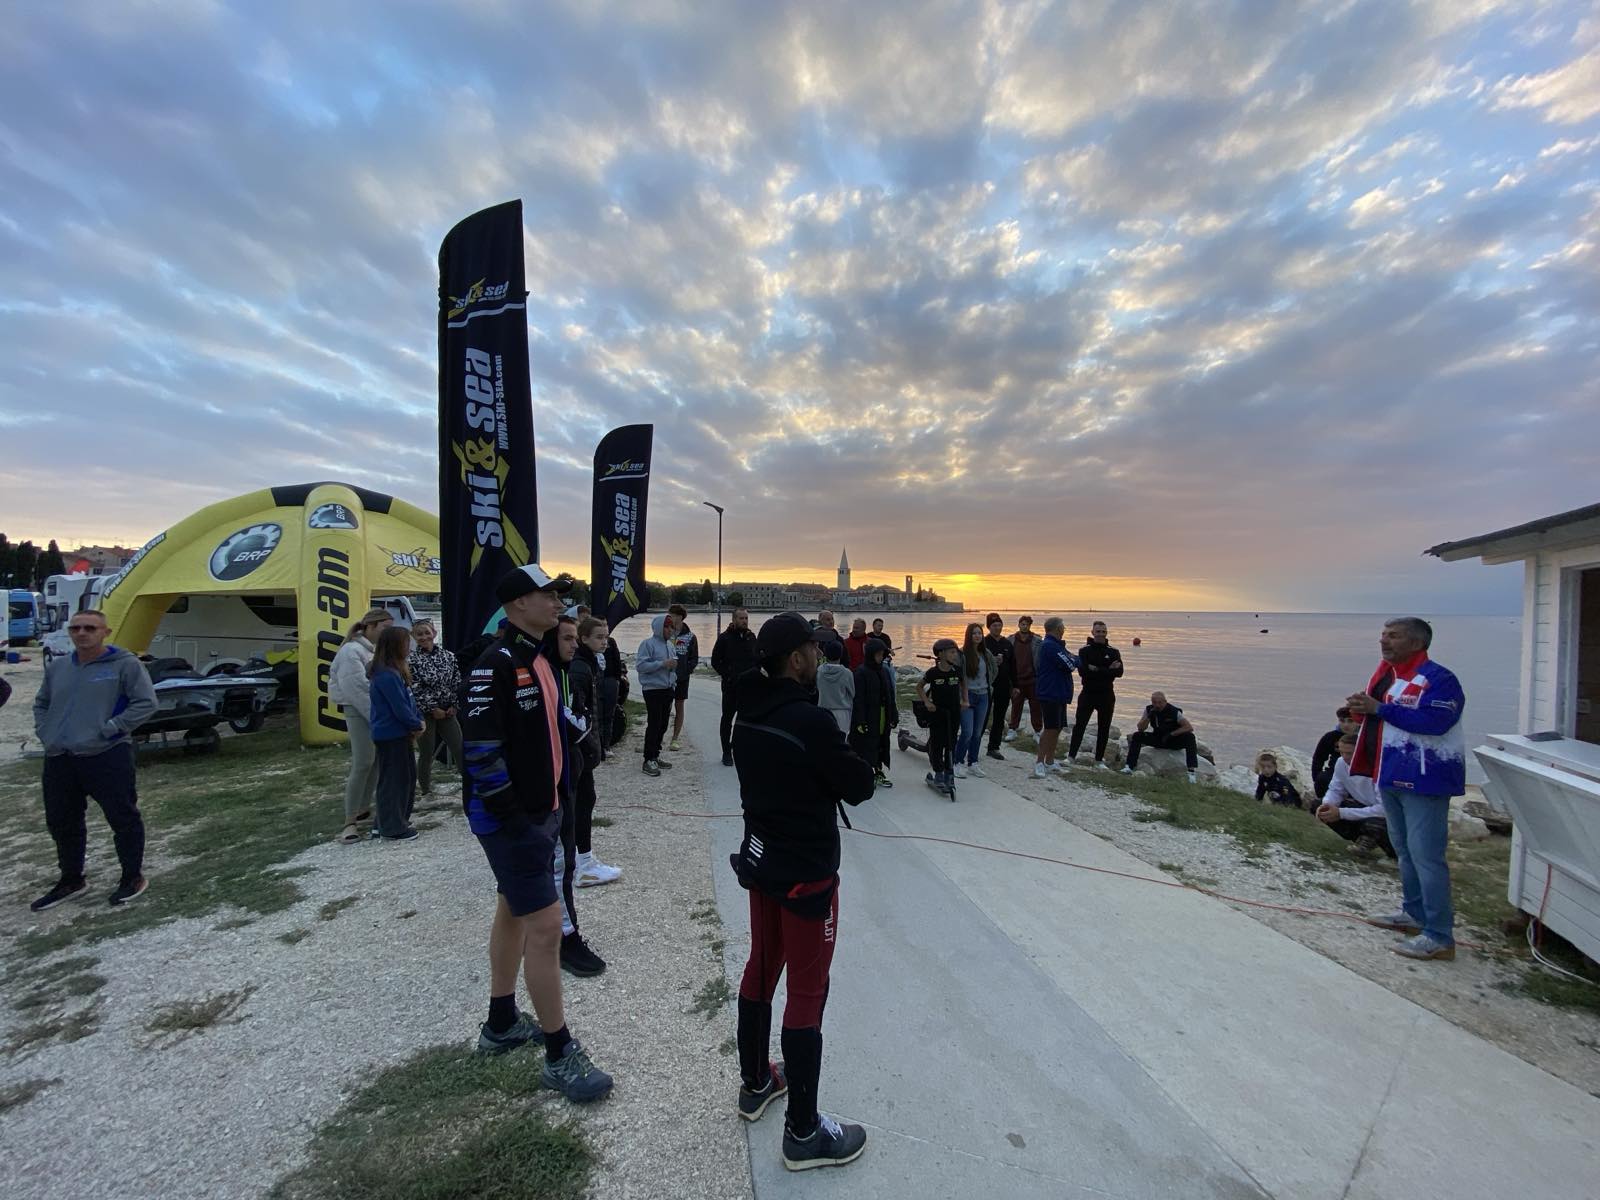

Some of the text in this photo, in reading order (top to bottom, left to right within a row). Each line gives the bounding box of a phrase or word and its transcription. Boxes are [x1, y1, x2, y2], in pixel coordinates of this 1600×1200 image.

[464, 347, 495, 433] sea
[465, 436, 496, 471] &
[334, 505, 346, 520] BRP
[614, 492, 631, 537] sea
[233, 549, 273, 562] BRP
[612, 537, 630, 556] &
